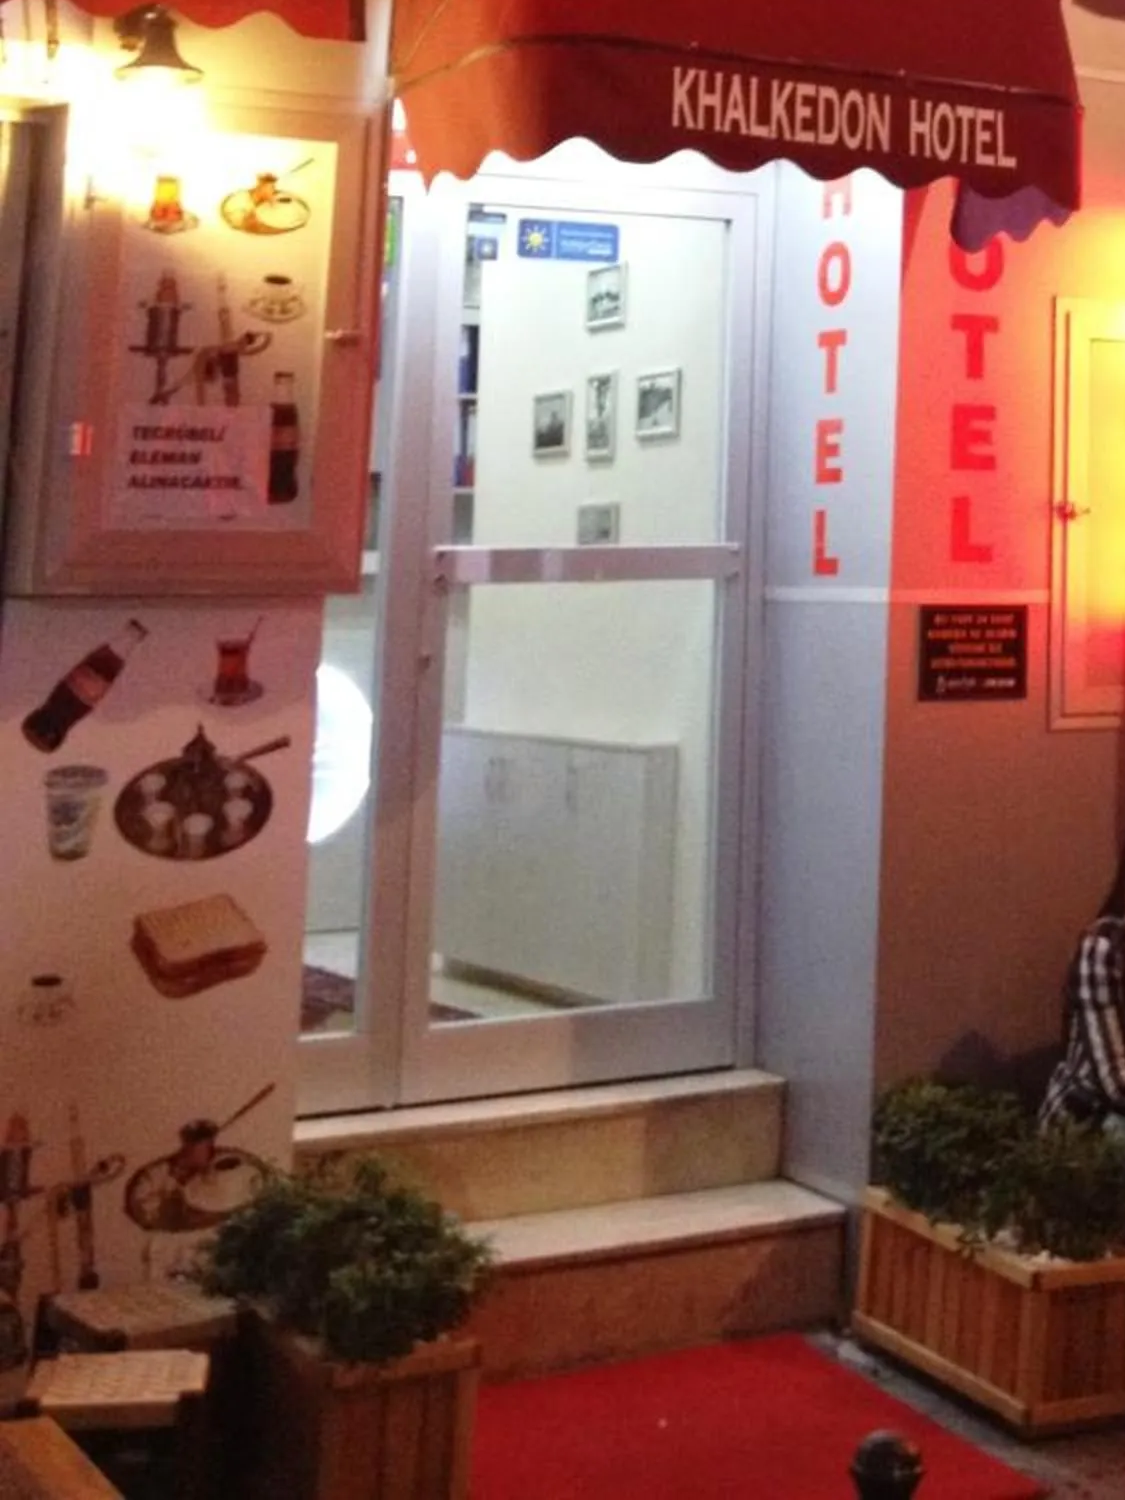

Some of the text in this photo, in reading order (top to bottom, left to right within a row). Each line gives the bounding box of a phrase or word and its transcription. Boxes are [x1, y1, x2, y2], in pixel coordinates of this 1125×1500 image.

[672, 66, 1017, 168] KHALKEDON HOTEL
[949, 233, 1004, 563] OTEL
